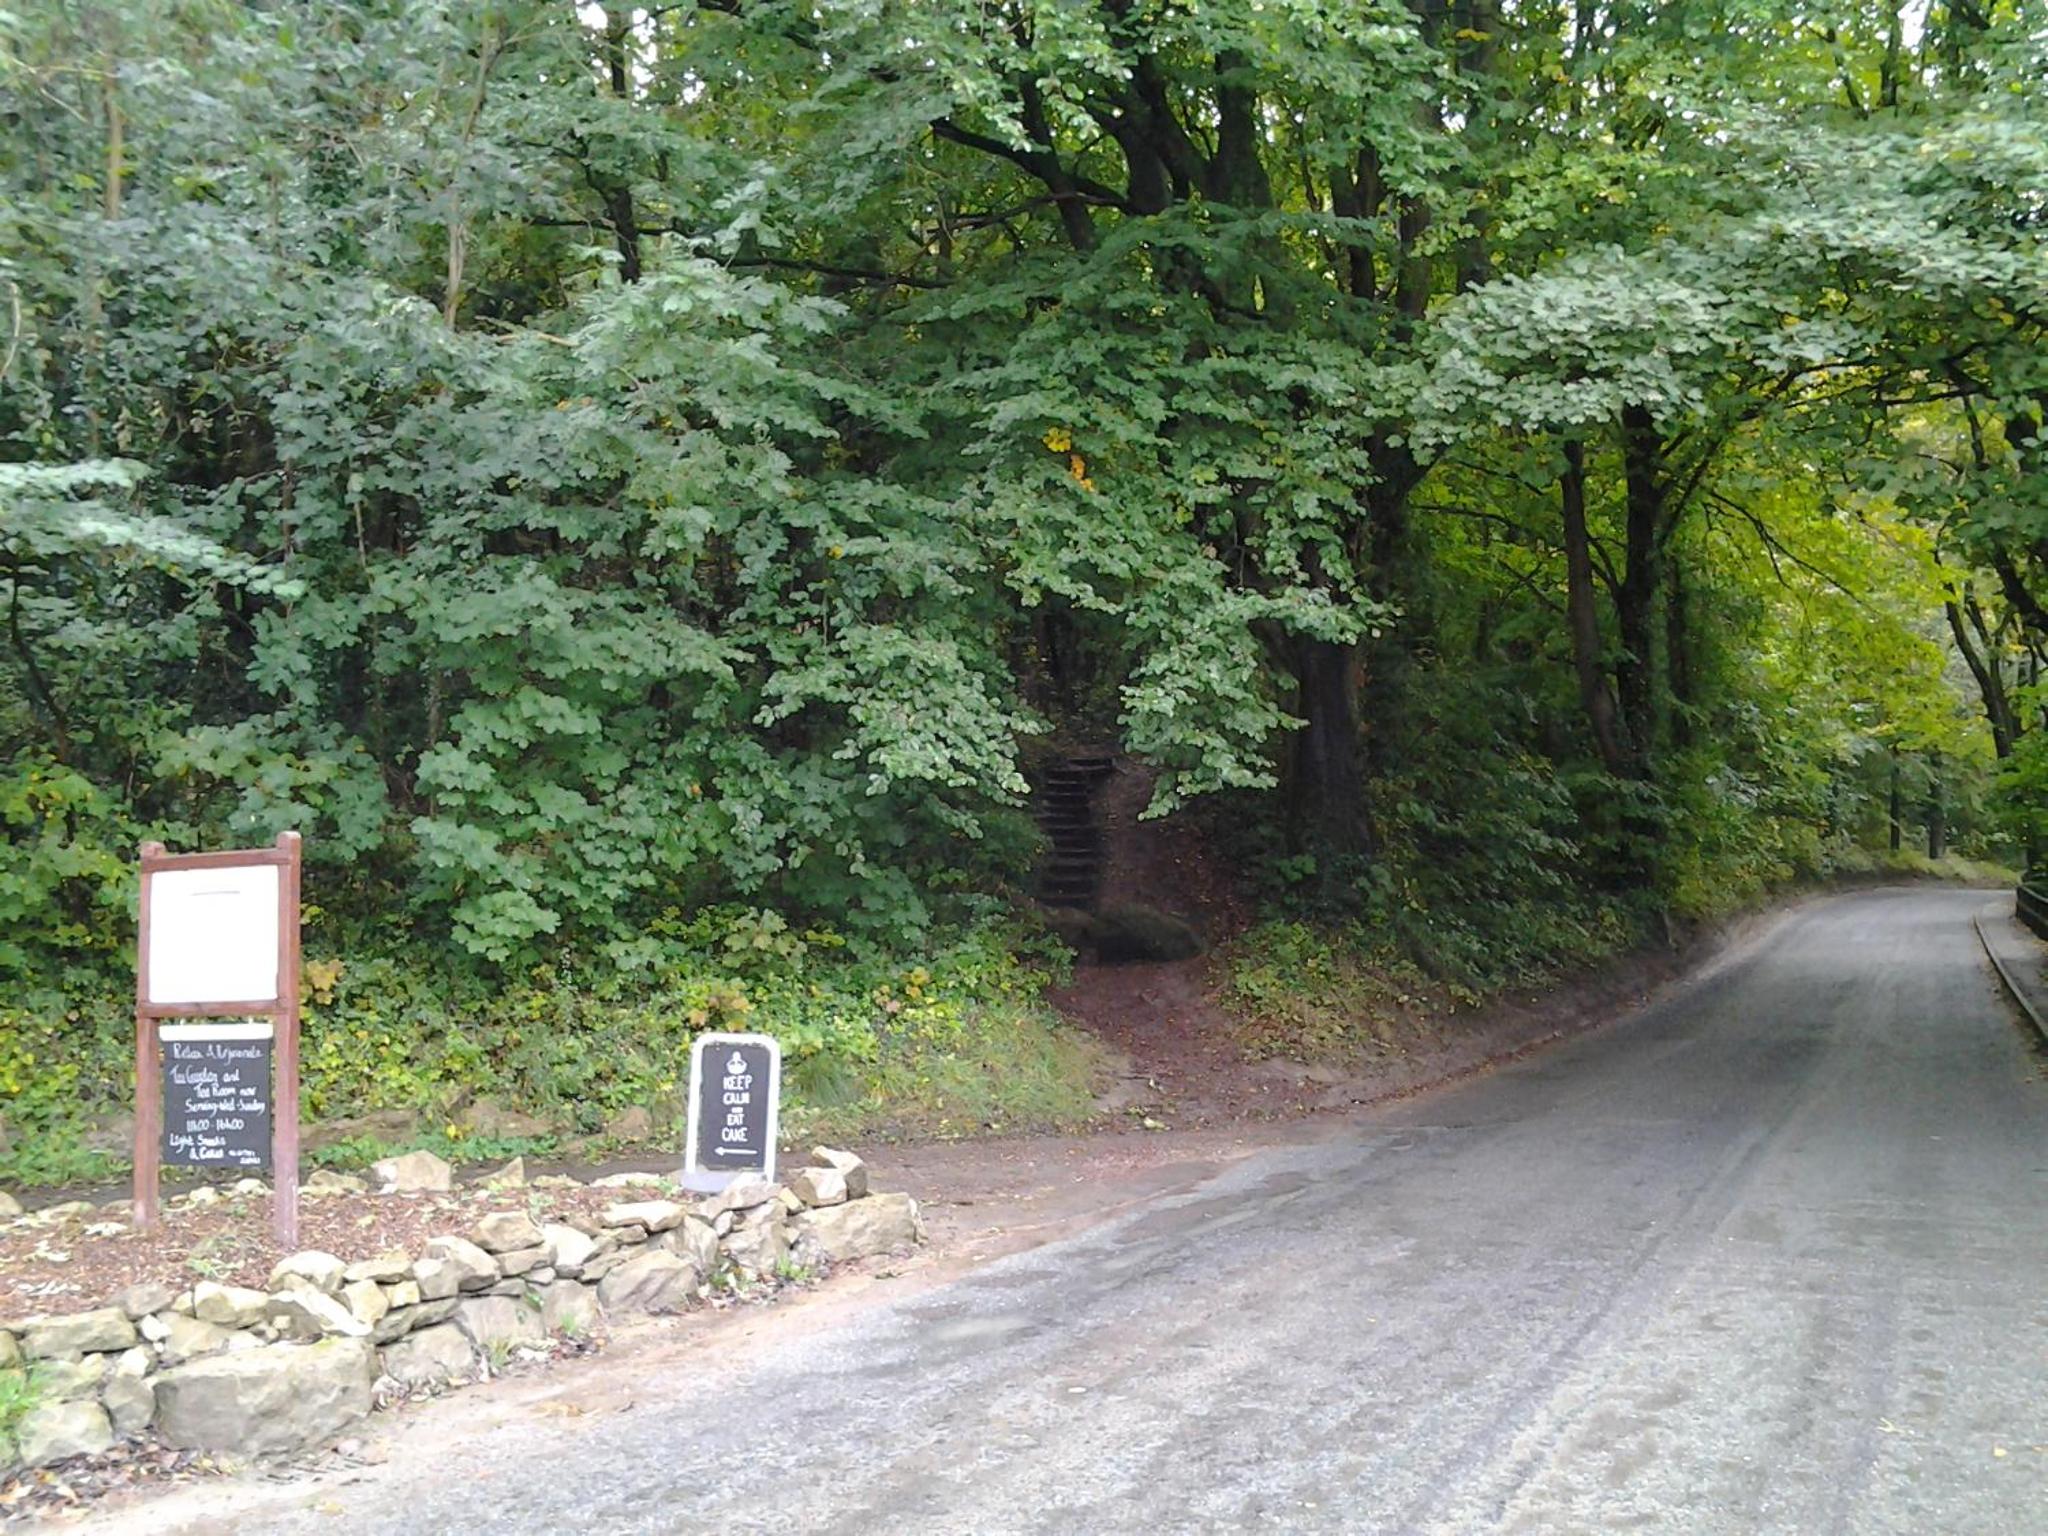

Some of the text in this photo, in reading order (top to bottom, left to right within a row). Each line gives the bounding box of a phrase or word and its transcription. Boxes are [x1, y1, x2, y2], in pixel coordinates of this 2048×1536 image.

[223, 1069, 239, 1082] and
[723, 1075, 752, 1090] KEEP
[723, 1092, 750, 1105] CALM
[727, 1113, 744, 1126] EAT
[721, 1127, 748, 1142] CAKE
